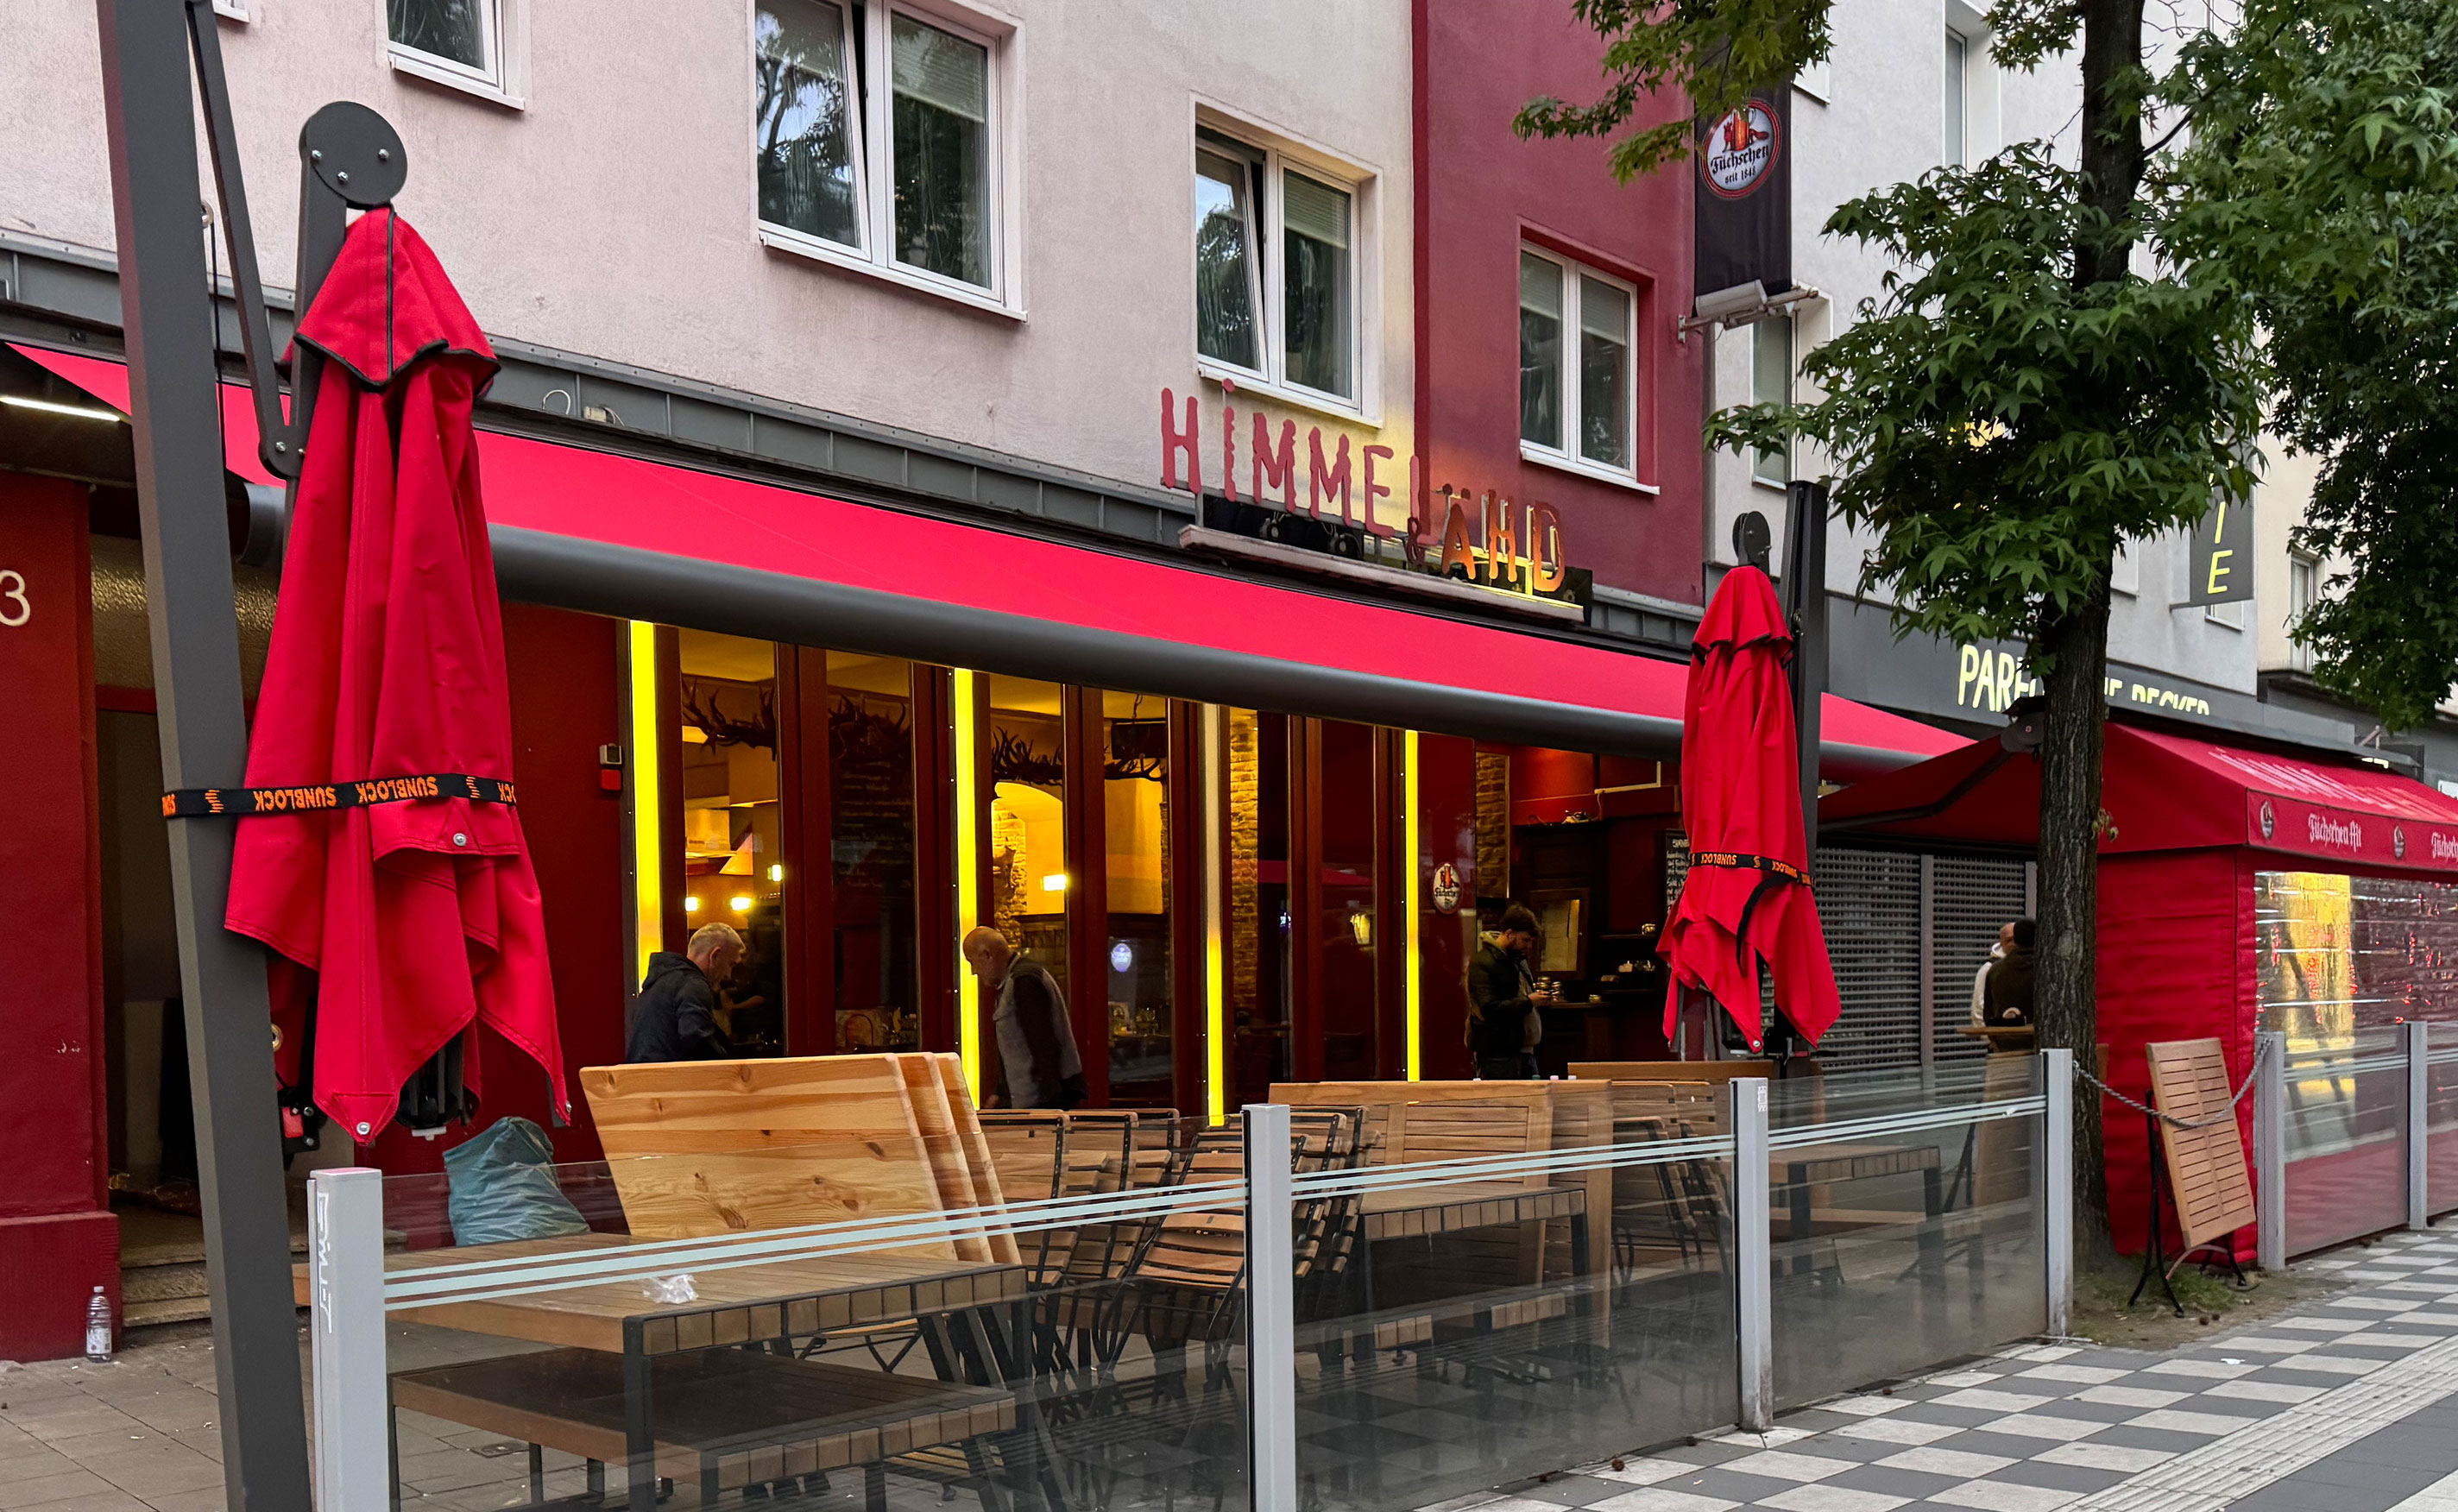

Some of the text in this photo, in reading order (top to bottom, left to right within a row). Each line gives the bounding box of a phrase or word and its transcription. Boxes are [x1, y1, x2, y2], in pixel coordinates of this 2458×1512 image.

[1711, 145, 1769, 174] Füchschen
[0, 569, 31, 627] 3
[253, 786, 337, 812] SUNBLOCK
[355, 776, 439, 804] SUNBLOCK
